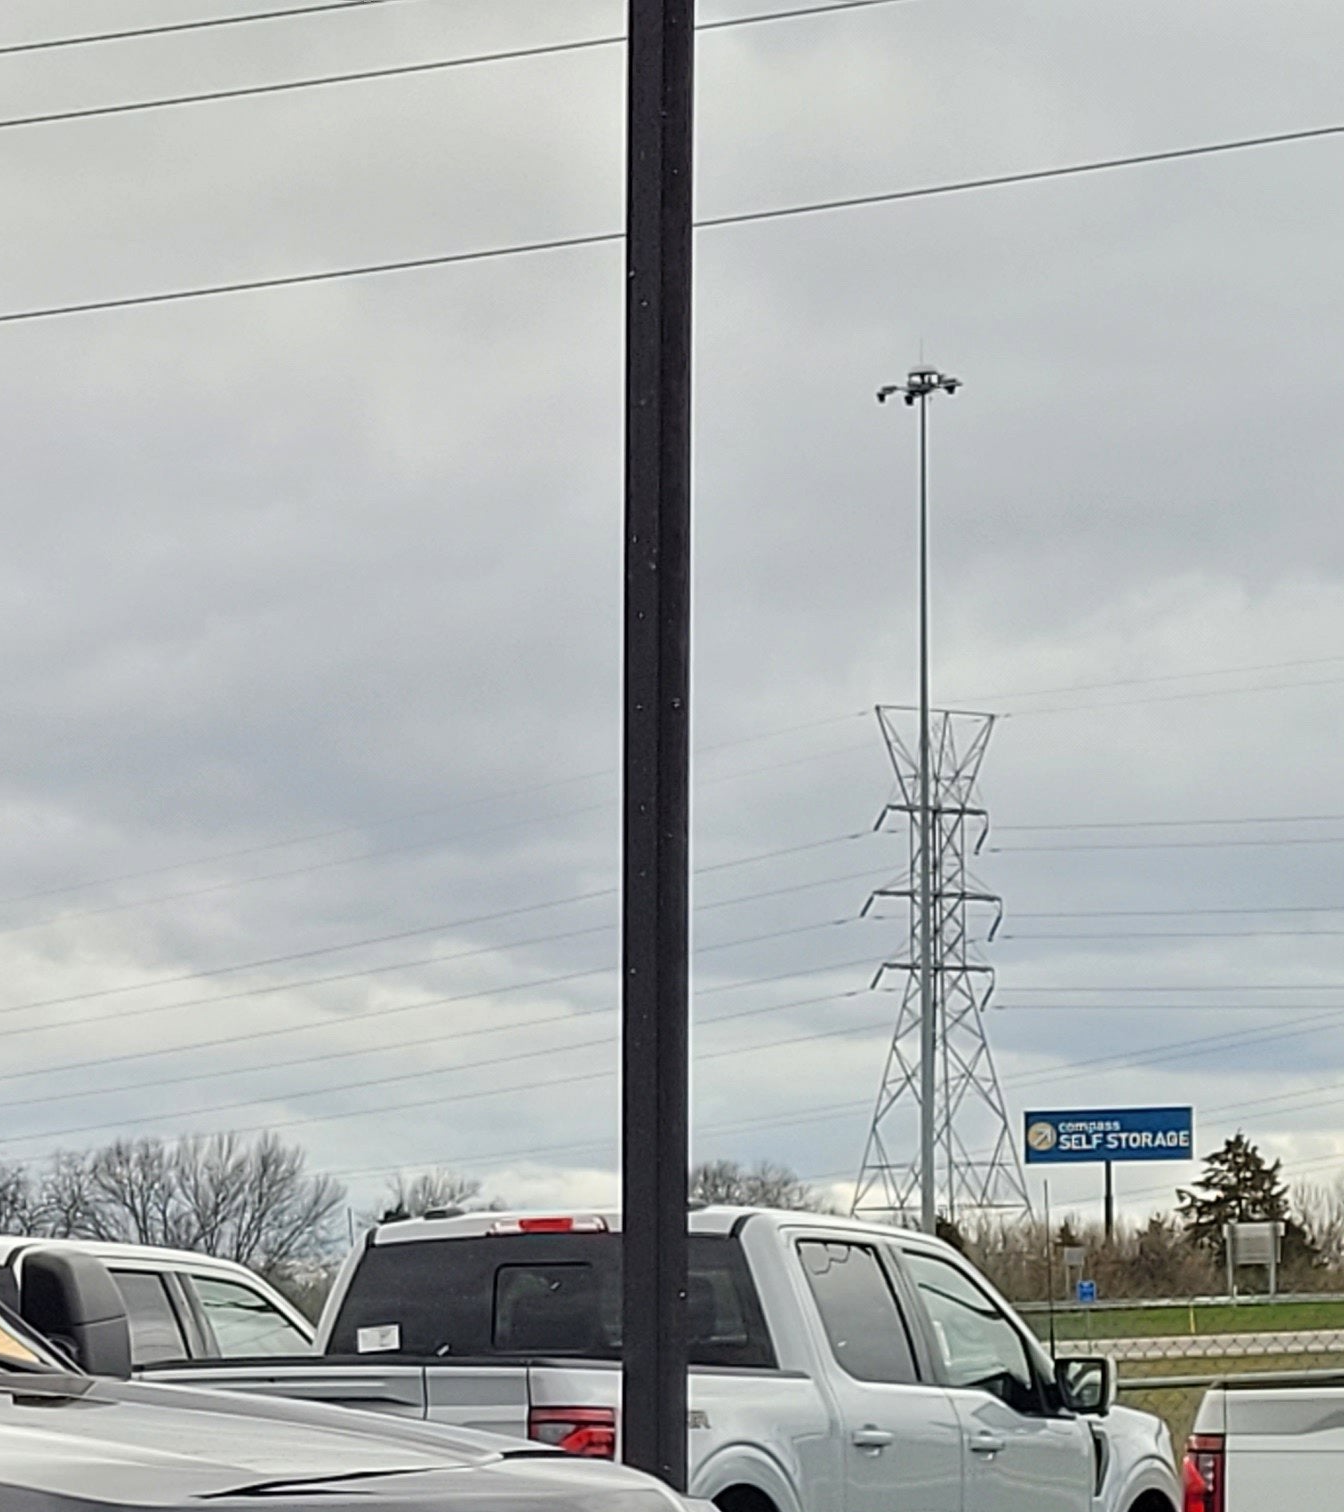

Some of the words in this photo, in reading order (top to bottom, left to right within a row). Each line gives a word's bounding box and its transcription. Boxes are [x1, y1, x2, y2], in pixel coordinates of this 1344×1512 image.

[1058, 1121, 1120, 1133] compass
[1059, 1133, 1103, 1149] SELF
[1106, 1131, 1189, 1149] STORAGE
